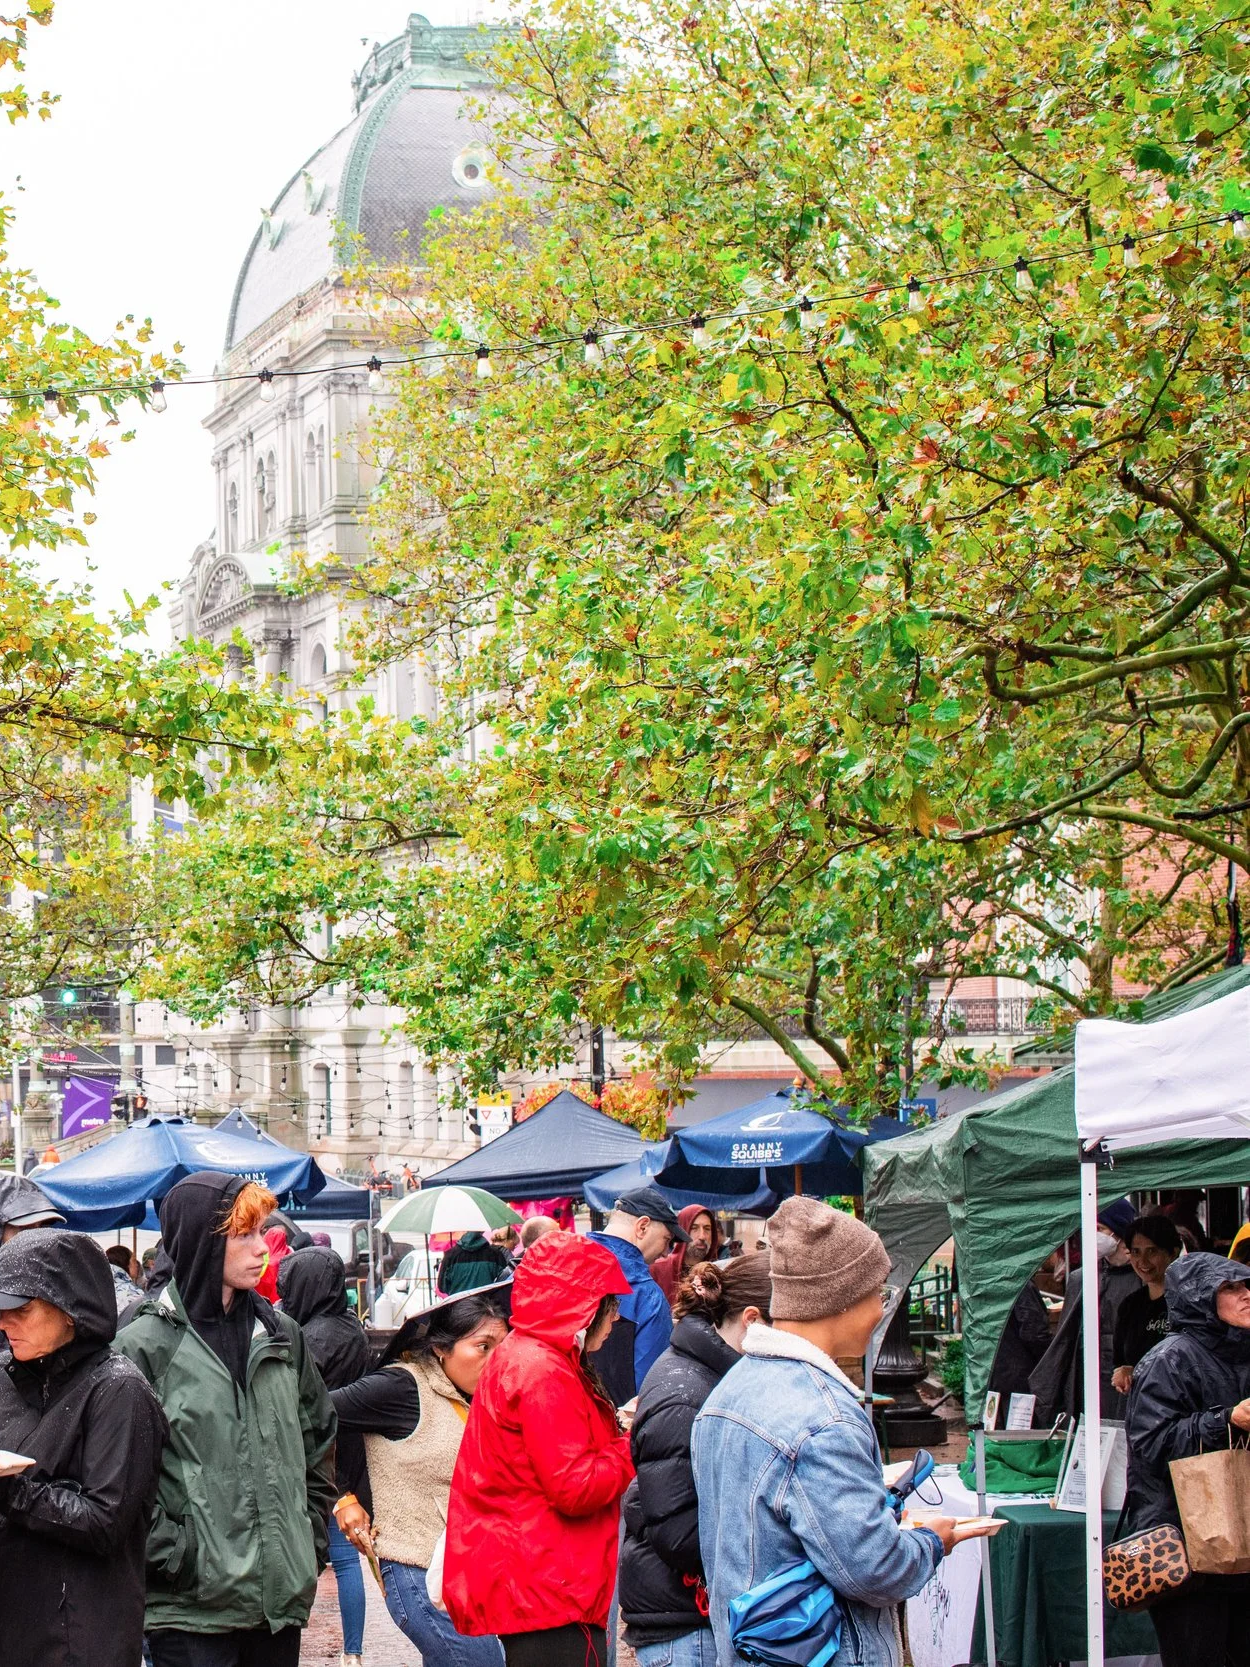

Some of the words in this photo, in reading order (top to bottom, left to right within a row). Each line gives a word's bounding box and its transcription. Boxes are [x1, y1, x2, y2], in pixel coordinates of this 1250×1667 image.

[732, 1142, 782, 1151] GRANNY
[731, 1149, 781, 1160] SQUIBB'S
[231, 1173, 266, 1181] ANNY
